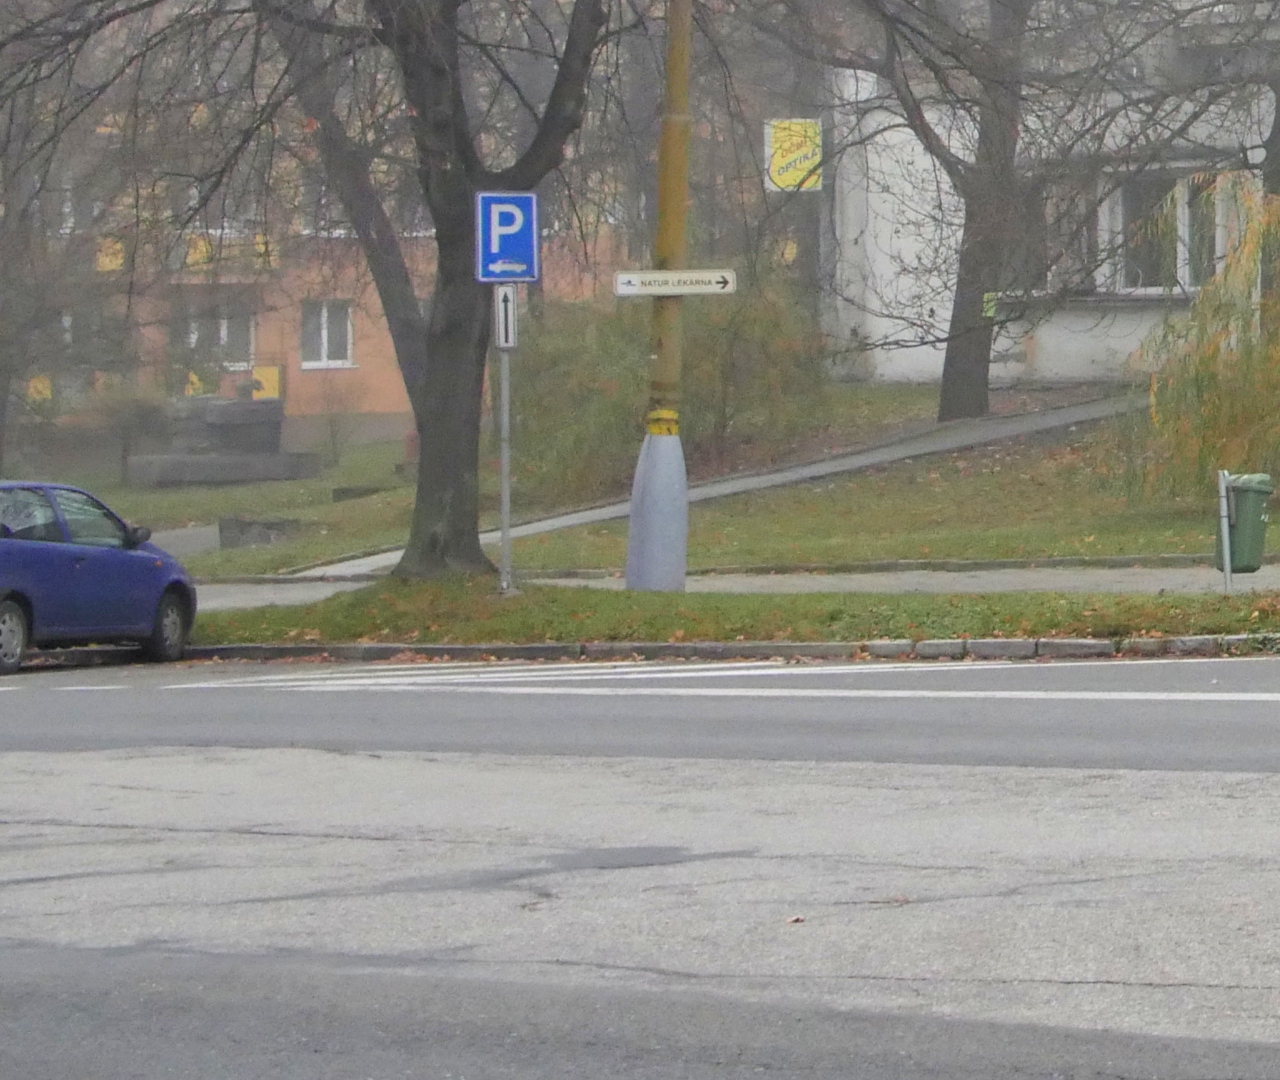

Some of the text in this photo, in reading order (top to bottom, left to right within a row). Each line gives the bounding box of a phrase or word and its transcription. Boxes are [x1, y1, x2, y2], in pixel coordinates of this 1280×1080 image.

[777, 148, 820, 177] OPTIKA
[490, 204, 524, 254] P
[640, 279, 670, 288] NATUR
